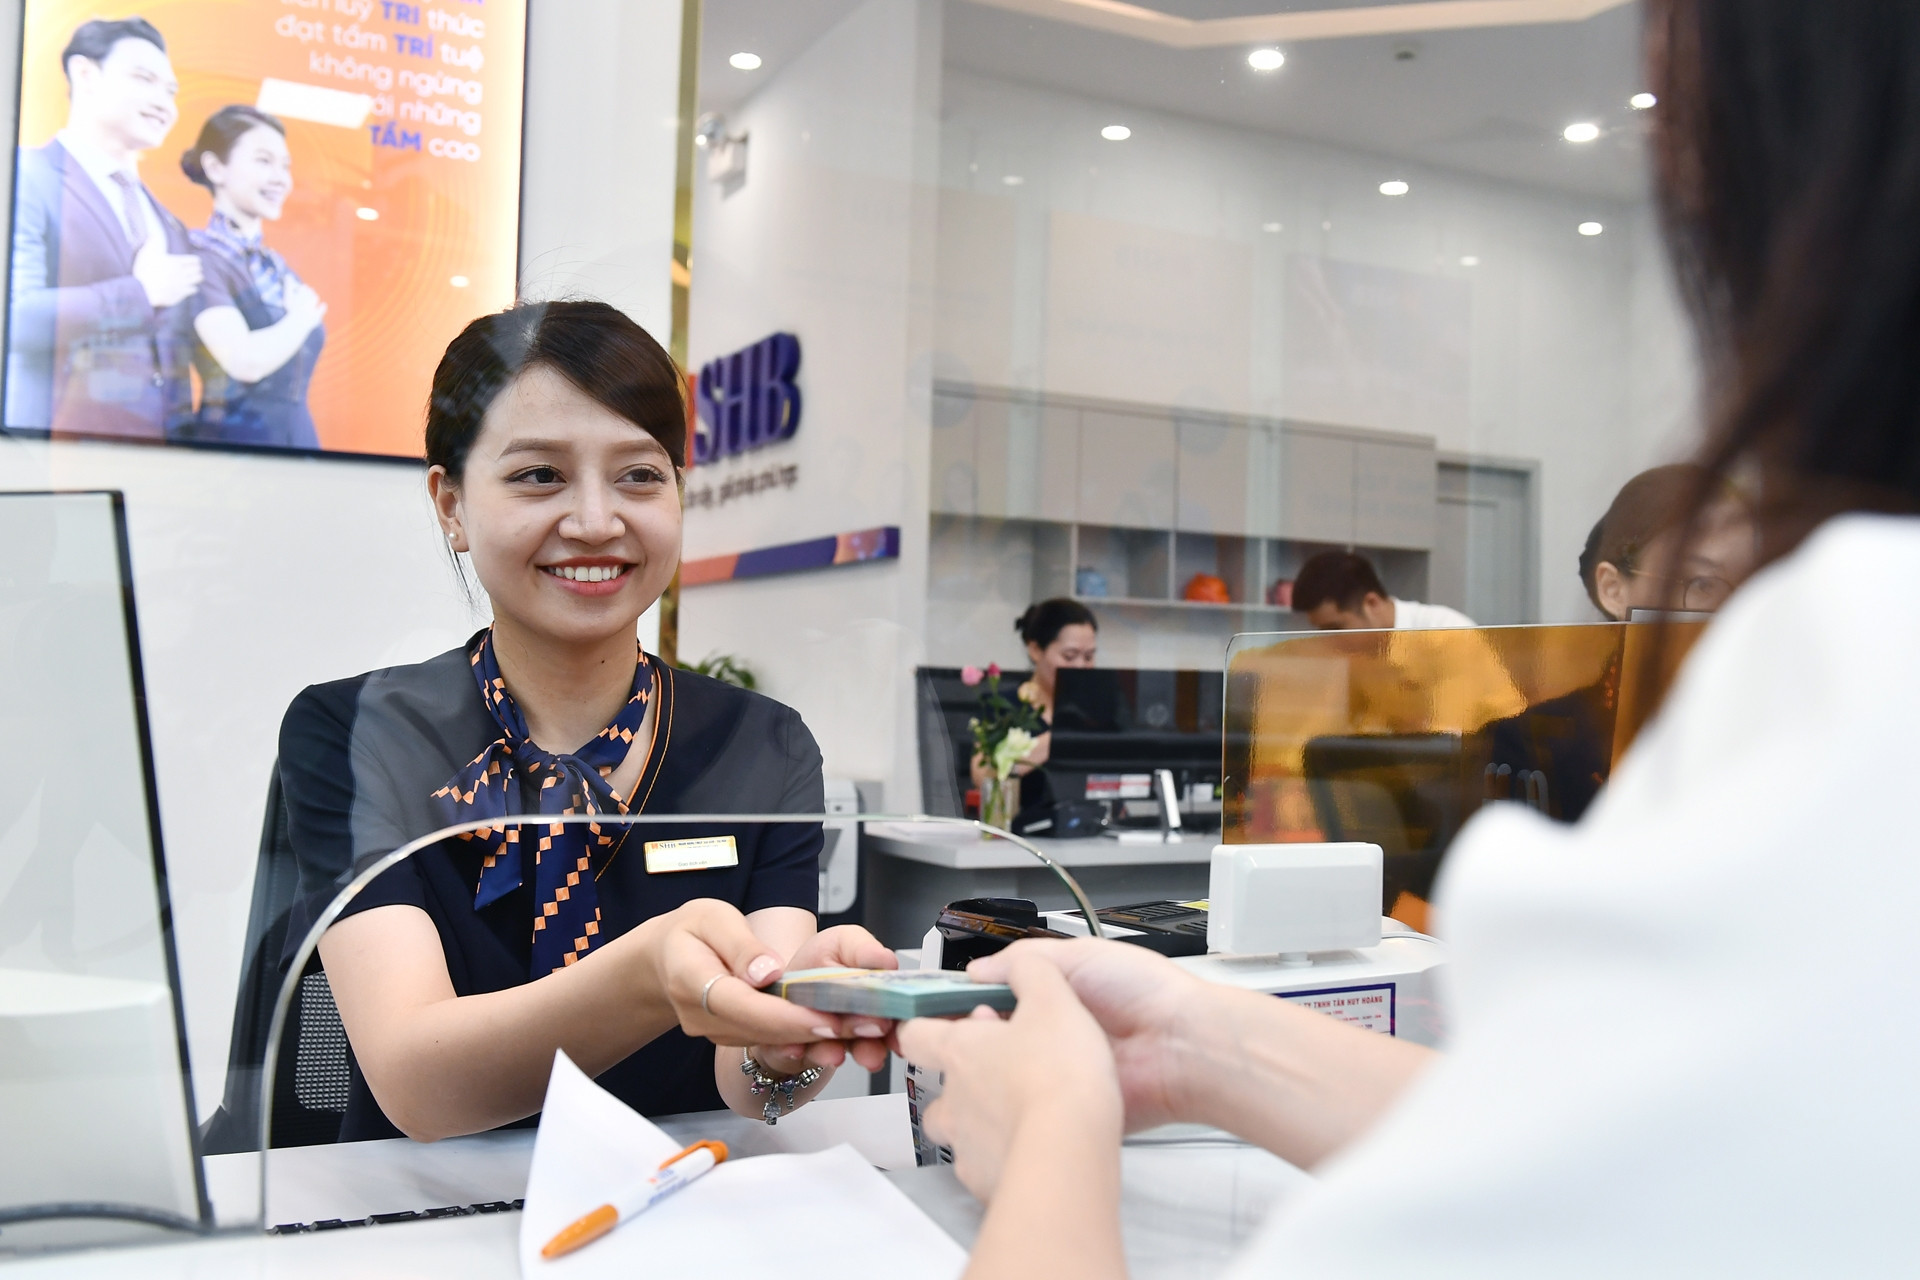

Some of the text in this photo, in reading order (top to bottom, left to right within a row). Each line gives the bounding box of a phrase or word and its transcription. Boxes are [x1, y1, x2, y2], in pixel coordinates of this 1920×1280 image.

[427, 9, 485, 39] thức
[275, 14, 325, 44] đạt
[394, 34, 434, 59] TRÍ
[440, 43, 485, 73] tuệ
[309, 51, 393, 91] không
[399, 99, 482, 136] những
[428, 138, 481, 162] cao
[693, 331, 802, 467] SHB
